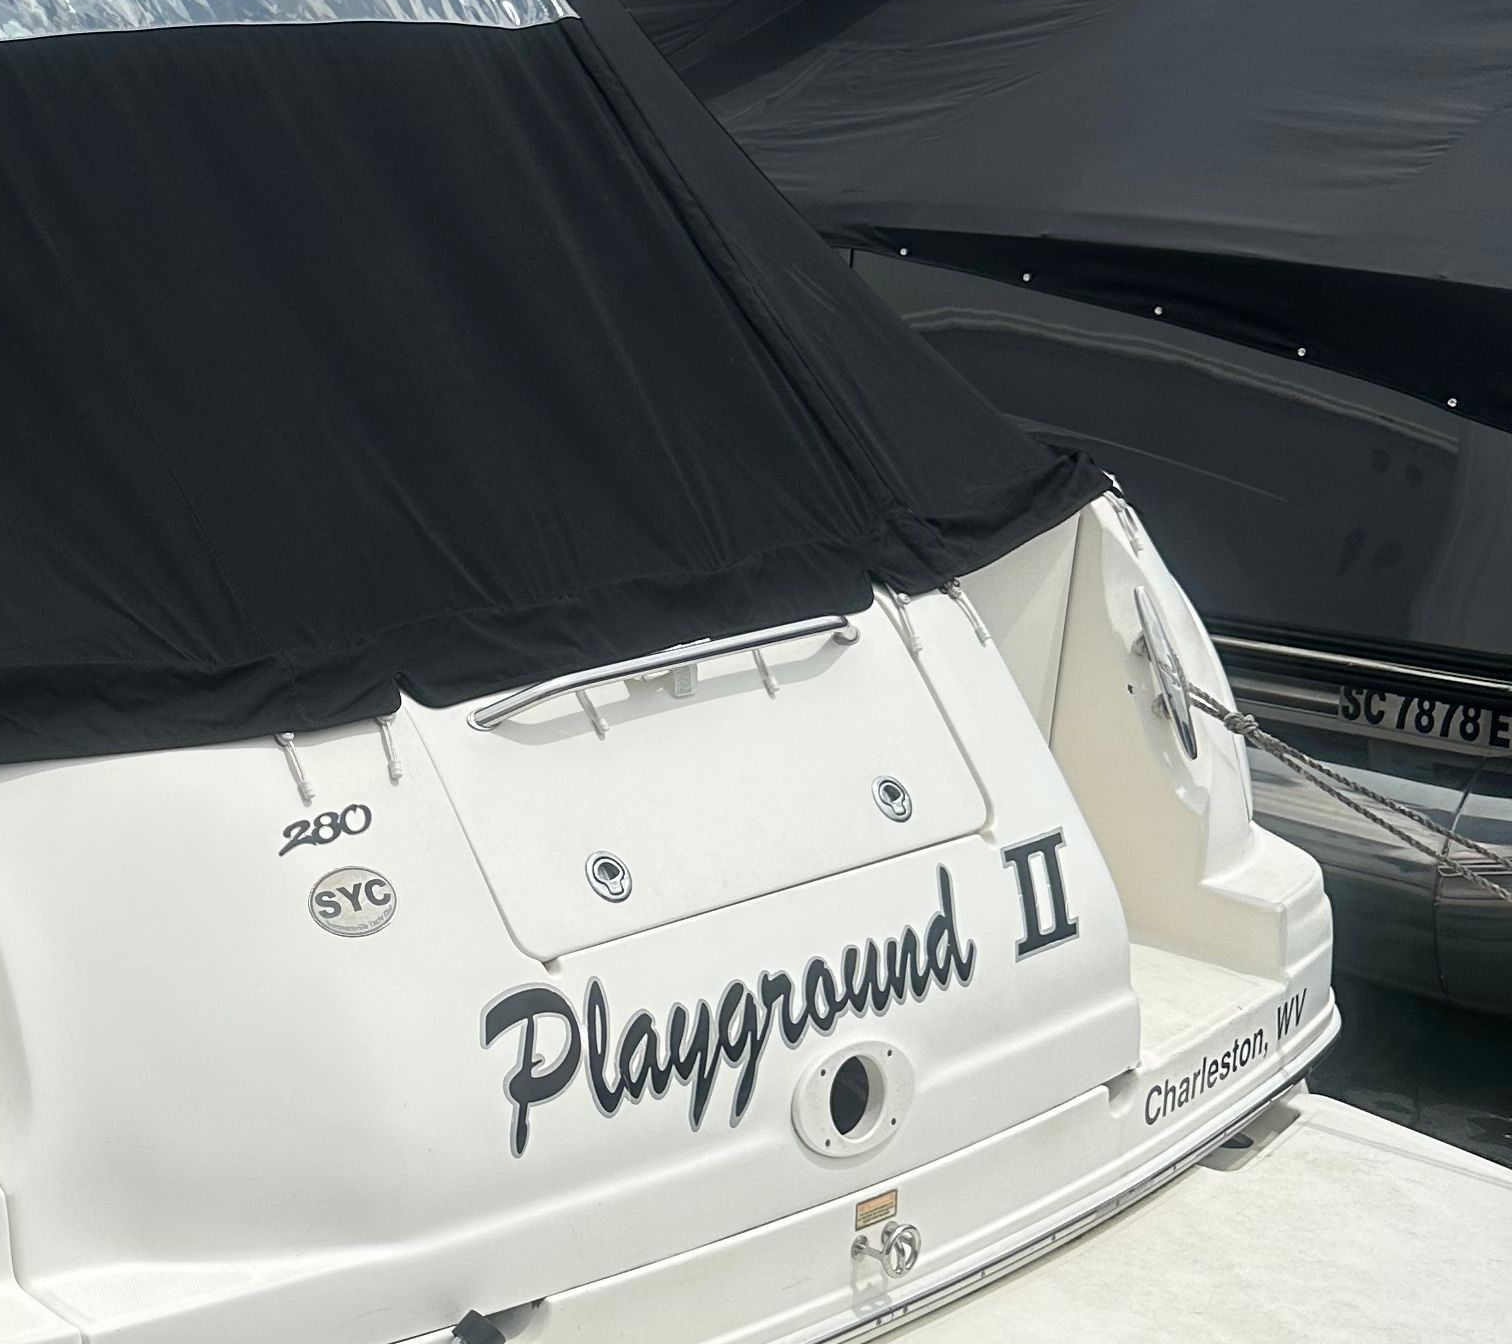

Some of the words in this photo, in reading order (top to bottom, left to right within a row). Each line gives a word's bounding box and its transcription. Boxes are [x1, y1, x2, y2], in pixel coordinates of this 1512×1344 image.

[1341, 685, 1387, 726] SC
[1395, 696, 1481, 742] 7878
[277, 803, 372, 857] 280
[314, 878, 392, 919] SYC
[480, 863, 977, 1159] Playground
[1000, 826, 1080, 963] II
[1144, 1027, 1269, 1126] Charleston,
[1277, 988, 1308, 1040] WV
